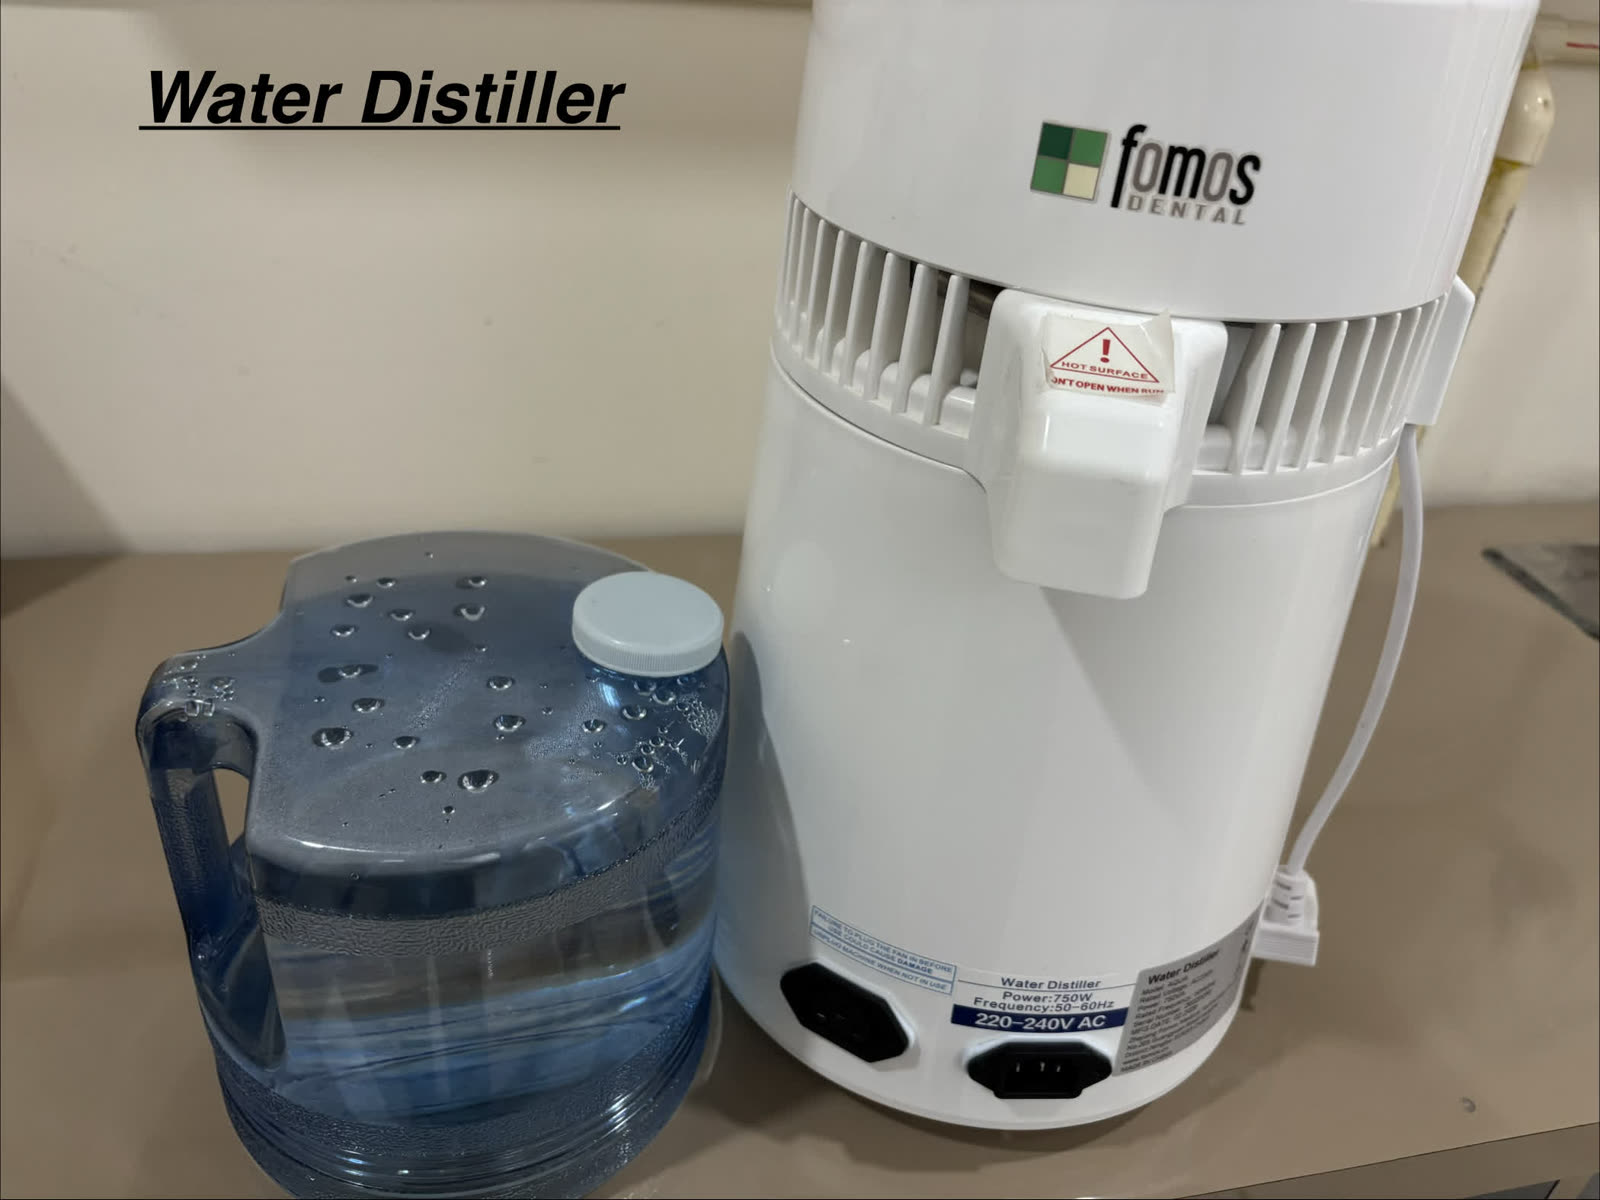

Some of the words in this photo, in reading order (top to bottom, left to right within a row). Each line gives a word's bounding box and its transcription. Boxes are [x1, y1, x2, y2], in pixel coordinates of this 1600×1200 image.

[1110, 123, 1261, 208] fomos
[1126, 194, 1247, 225] DENTAL
[1061, 361, 1087, 370] HOT
[1089, 365, 1149, 379] SURFACE
[1075, 380, 1105, 391] OPEN
[1106, 385, 1139, 393] WHEN
[827, 925, 842, 937] USE
[843, 933, 869, 950] COULD
[869, 946, 896, 961] CAUSE
[897, 958, 934, 974] DAMAGE
[844, 925, 854, 936] TO
[854, 931, 875, 946] PLUG
[875, 942, 891, 953] THE
[892, 949, 908, 959] FAN
[918, 959, 953, 973] BEFORE
[813, 929, 842, 949] UNPLUG
[842, 945, 877, 965] MACHINE
[877, 962, 901, 976] WHEN
[901, 972, 920, 982] NOT
[929, 981, 948, 991] USE
[1001, 977, 1044, 989] Water
[1047, 979, 1102, 990] Distiller
[1148, 968, 1182, 985] Water
[1002, 991, 1093, 1003] Power:750W
[974, 1013, 1075, 1030] 220-240V
[1077, 1014, 1107, 1028] AC
